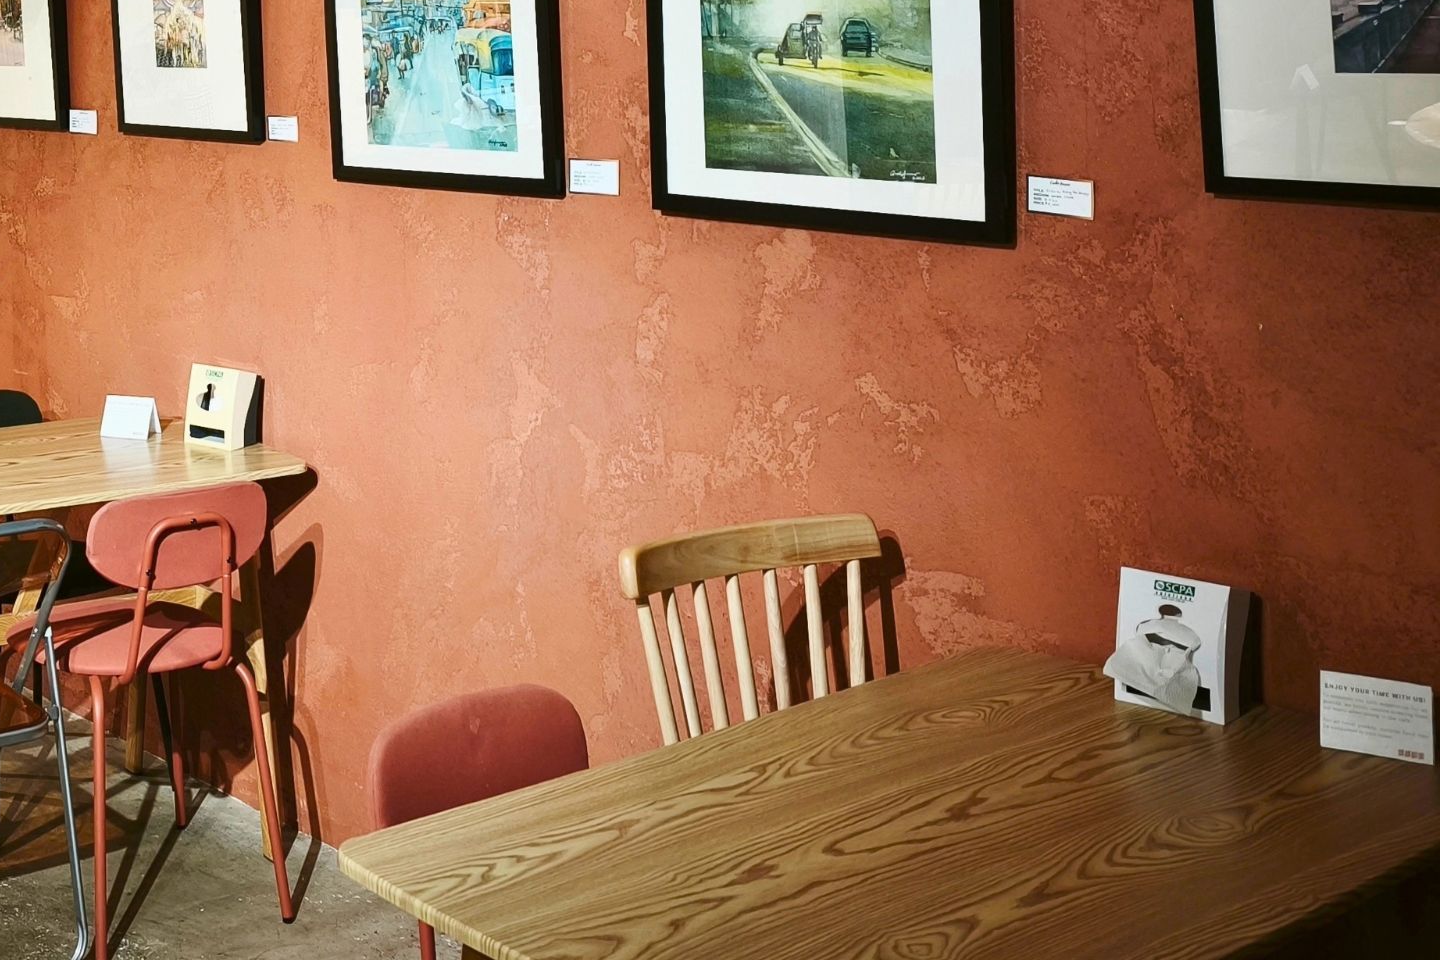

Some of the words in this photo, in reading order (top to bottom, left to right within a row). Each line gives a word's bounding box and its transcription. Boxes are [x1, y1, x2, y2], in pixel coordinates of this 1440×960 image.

[1324, 682, 1348, 691] ENJOY
[1350, 687, 1370, 695] YOUR
[1372, 690, 1390, 698] TIME
[1392, 693, 1411, 701] WITH
